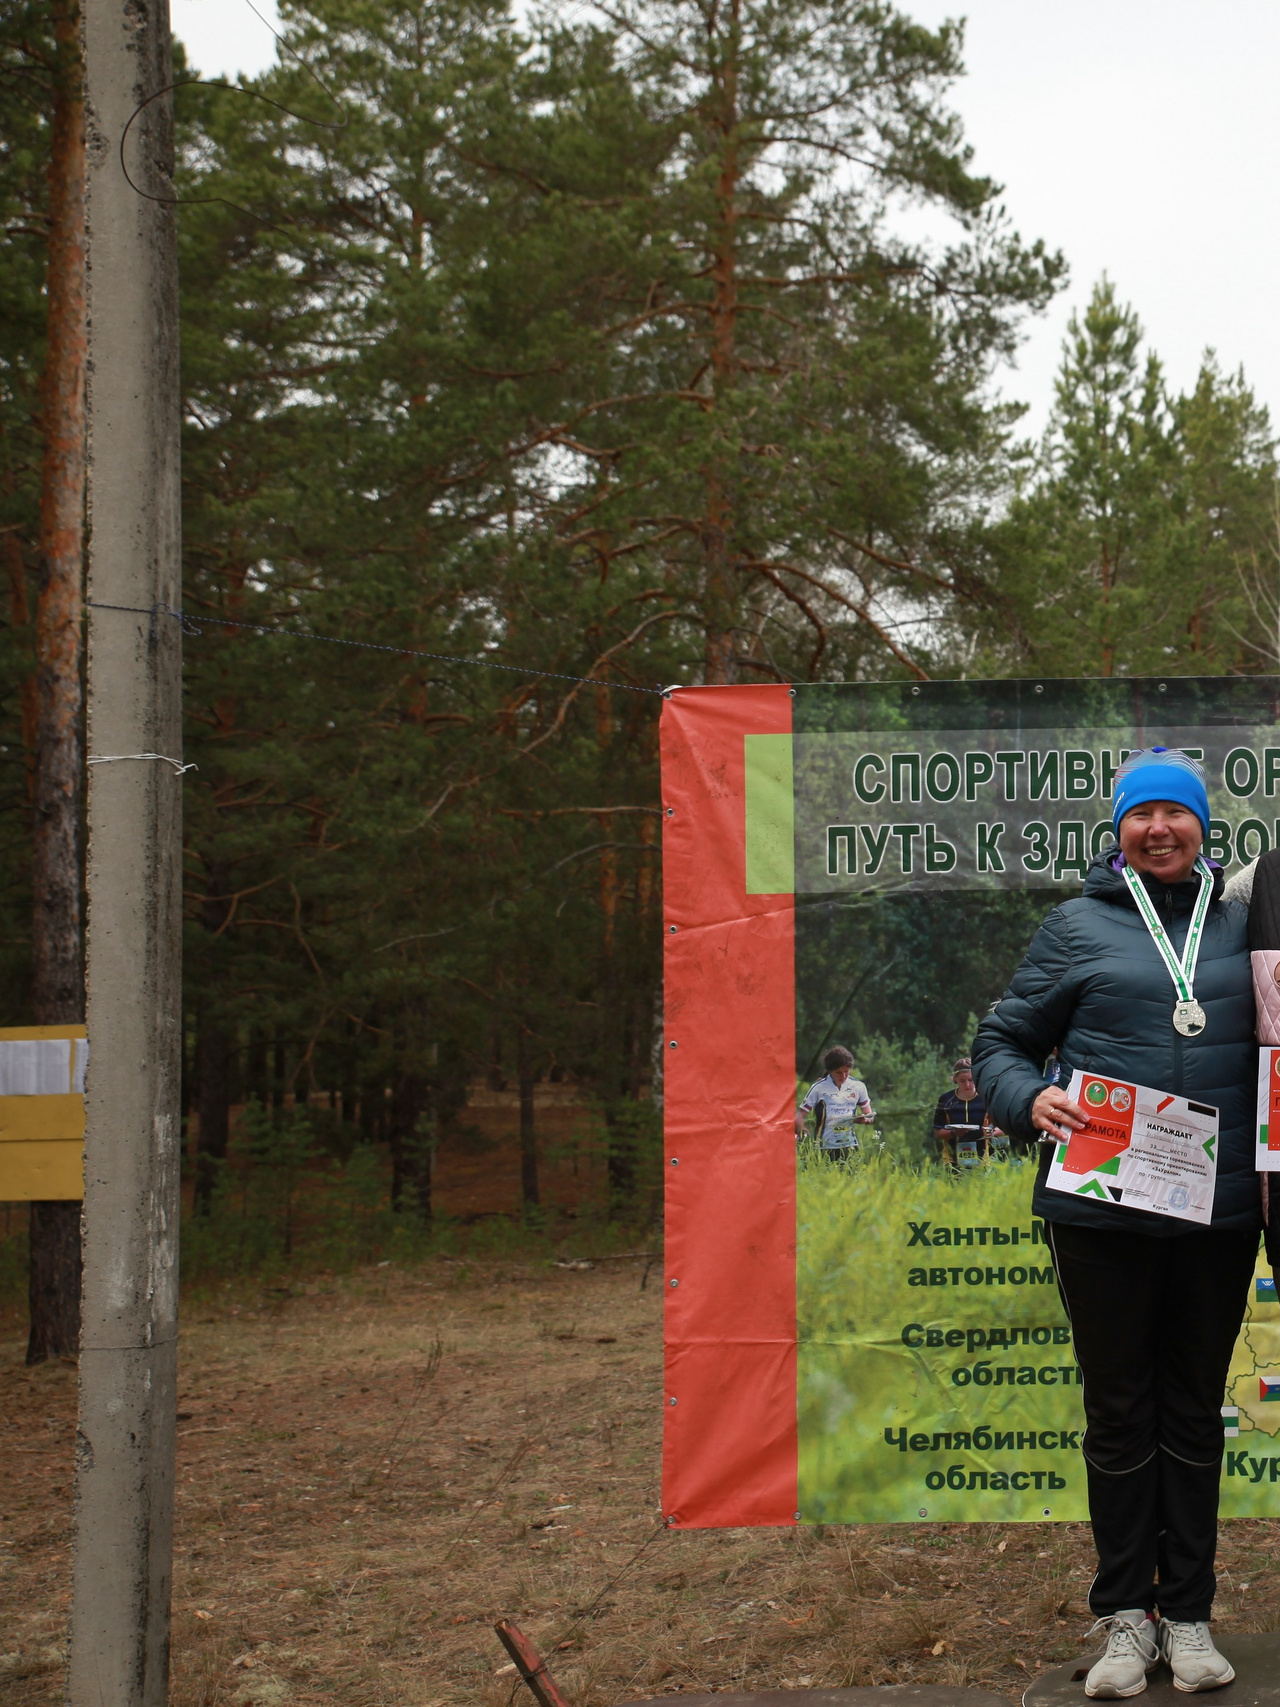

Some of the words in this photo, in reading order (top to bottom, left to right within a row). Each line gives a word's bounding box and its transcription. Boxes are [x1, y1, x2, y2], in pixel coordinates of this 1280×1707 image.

[853, 748, 1204, 804] СПОРТИВН
[827, 823, 956, 875] ПУТЬ
[976, 822, 1006, 873] К
[1084, 1123, 1127, 1140] РАМОТА
[1147, 1123, 1193, 1140] НАГРАЖДАЕТ
[1152, 1203, 1169, 1212] Курган
[907, 1266, 1055, 1287] автоном
[901, 1323, 1071, 1353] Свердлов
[884, 1425, 1086, 1452] Челябинск
[925, 1464, 1067, 1490] область
